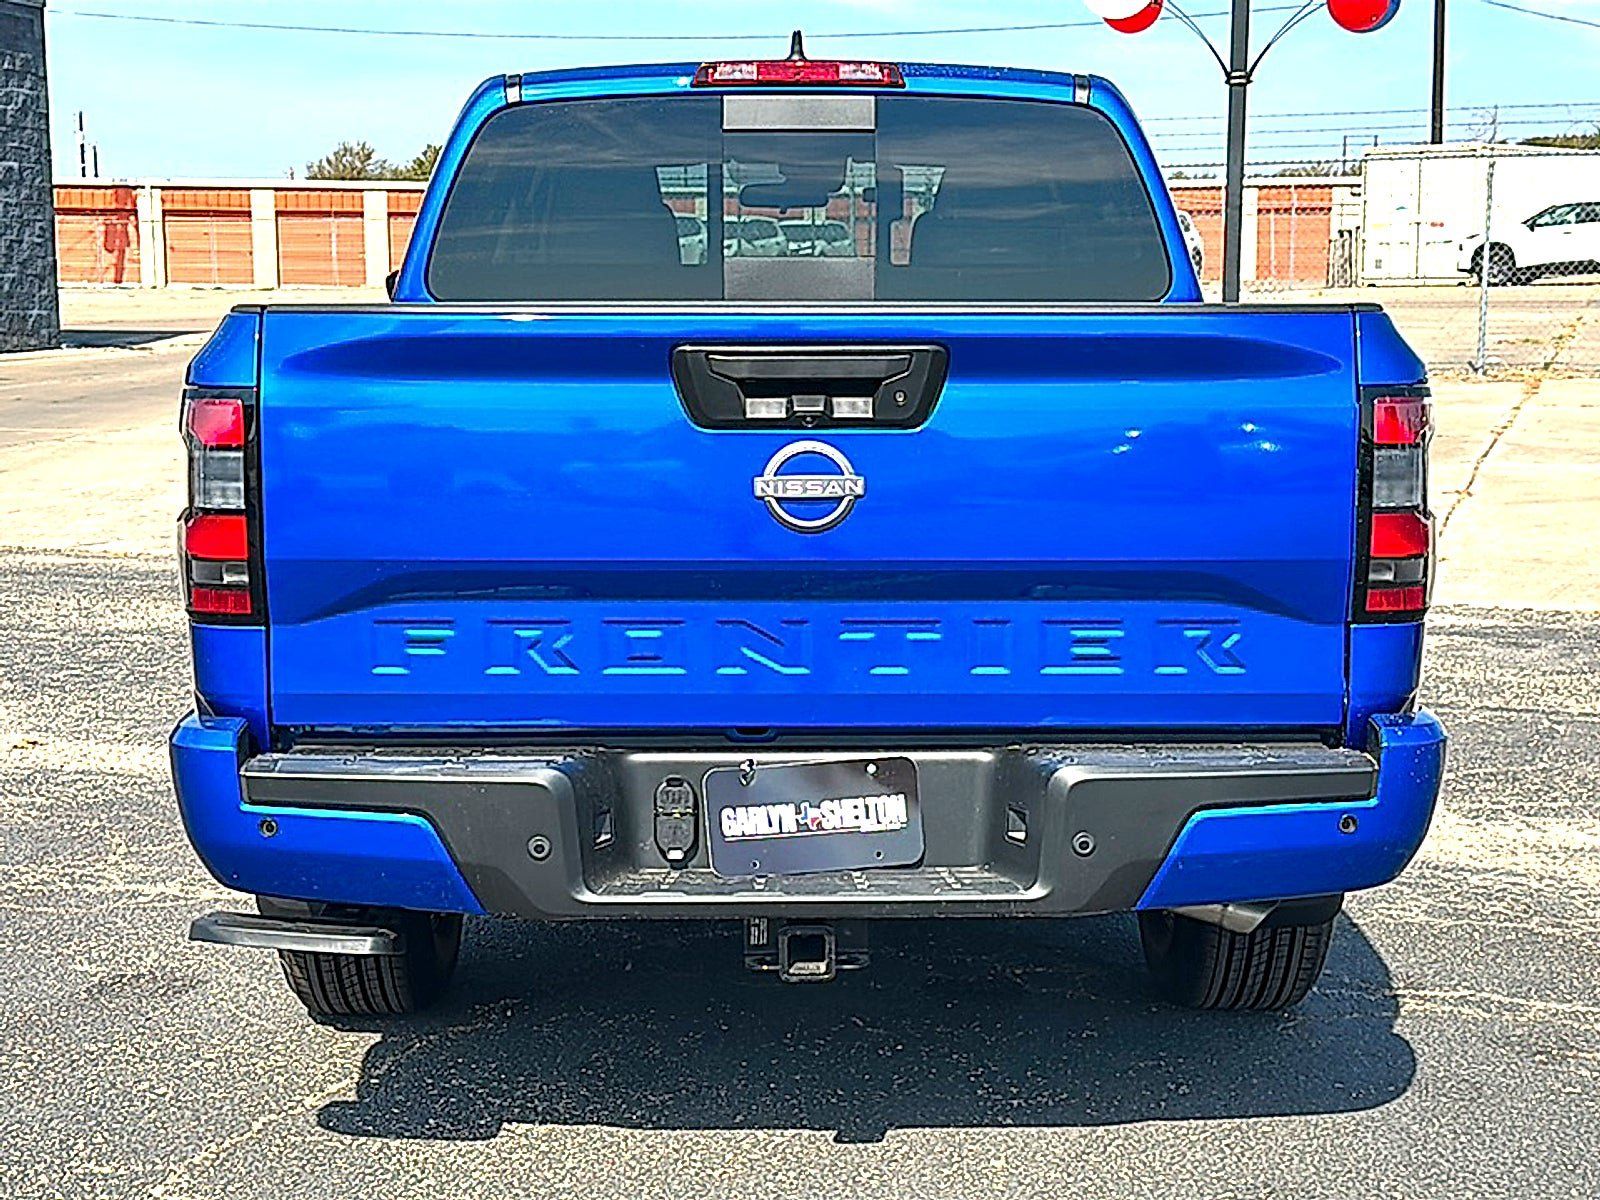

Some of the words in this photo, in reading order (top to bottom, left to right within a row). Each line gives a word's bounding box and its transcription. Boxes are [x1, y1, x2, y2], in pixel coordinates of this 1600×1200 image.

[756, 479, 863, 497] NISSAN
[372, 617, 1247, 676] FRONTIER
[721, 803, 798, 837] GARLYN
[819, 793, 908, 830] SHELTON
